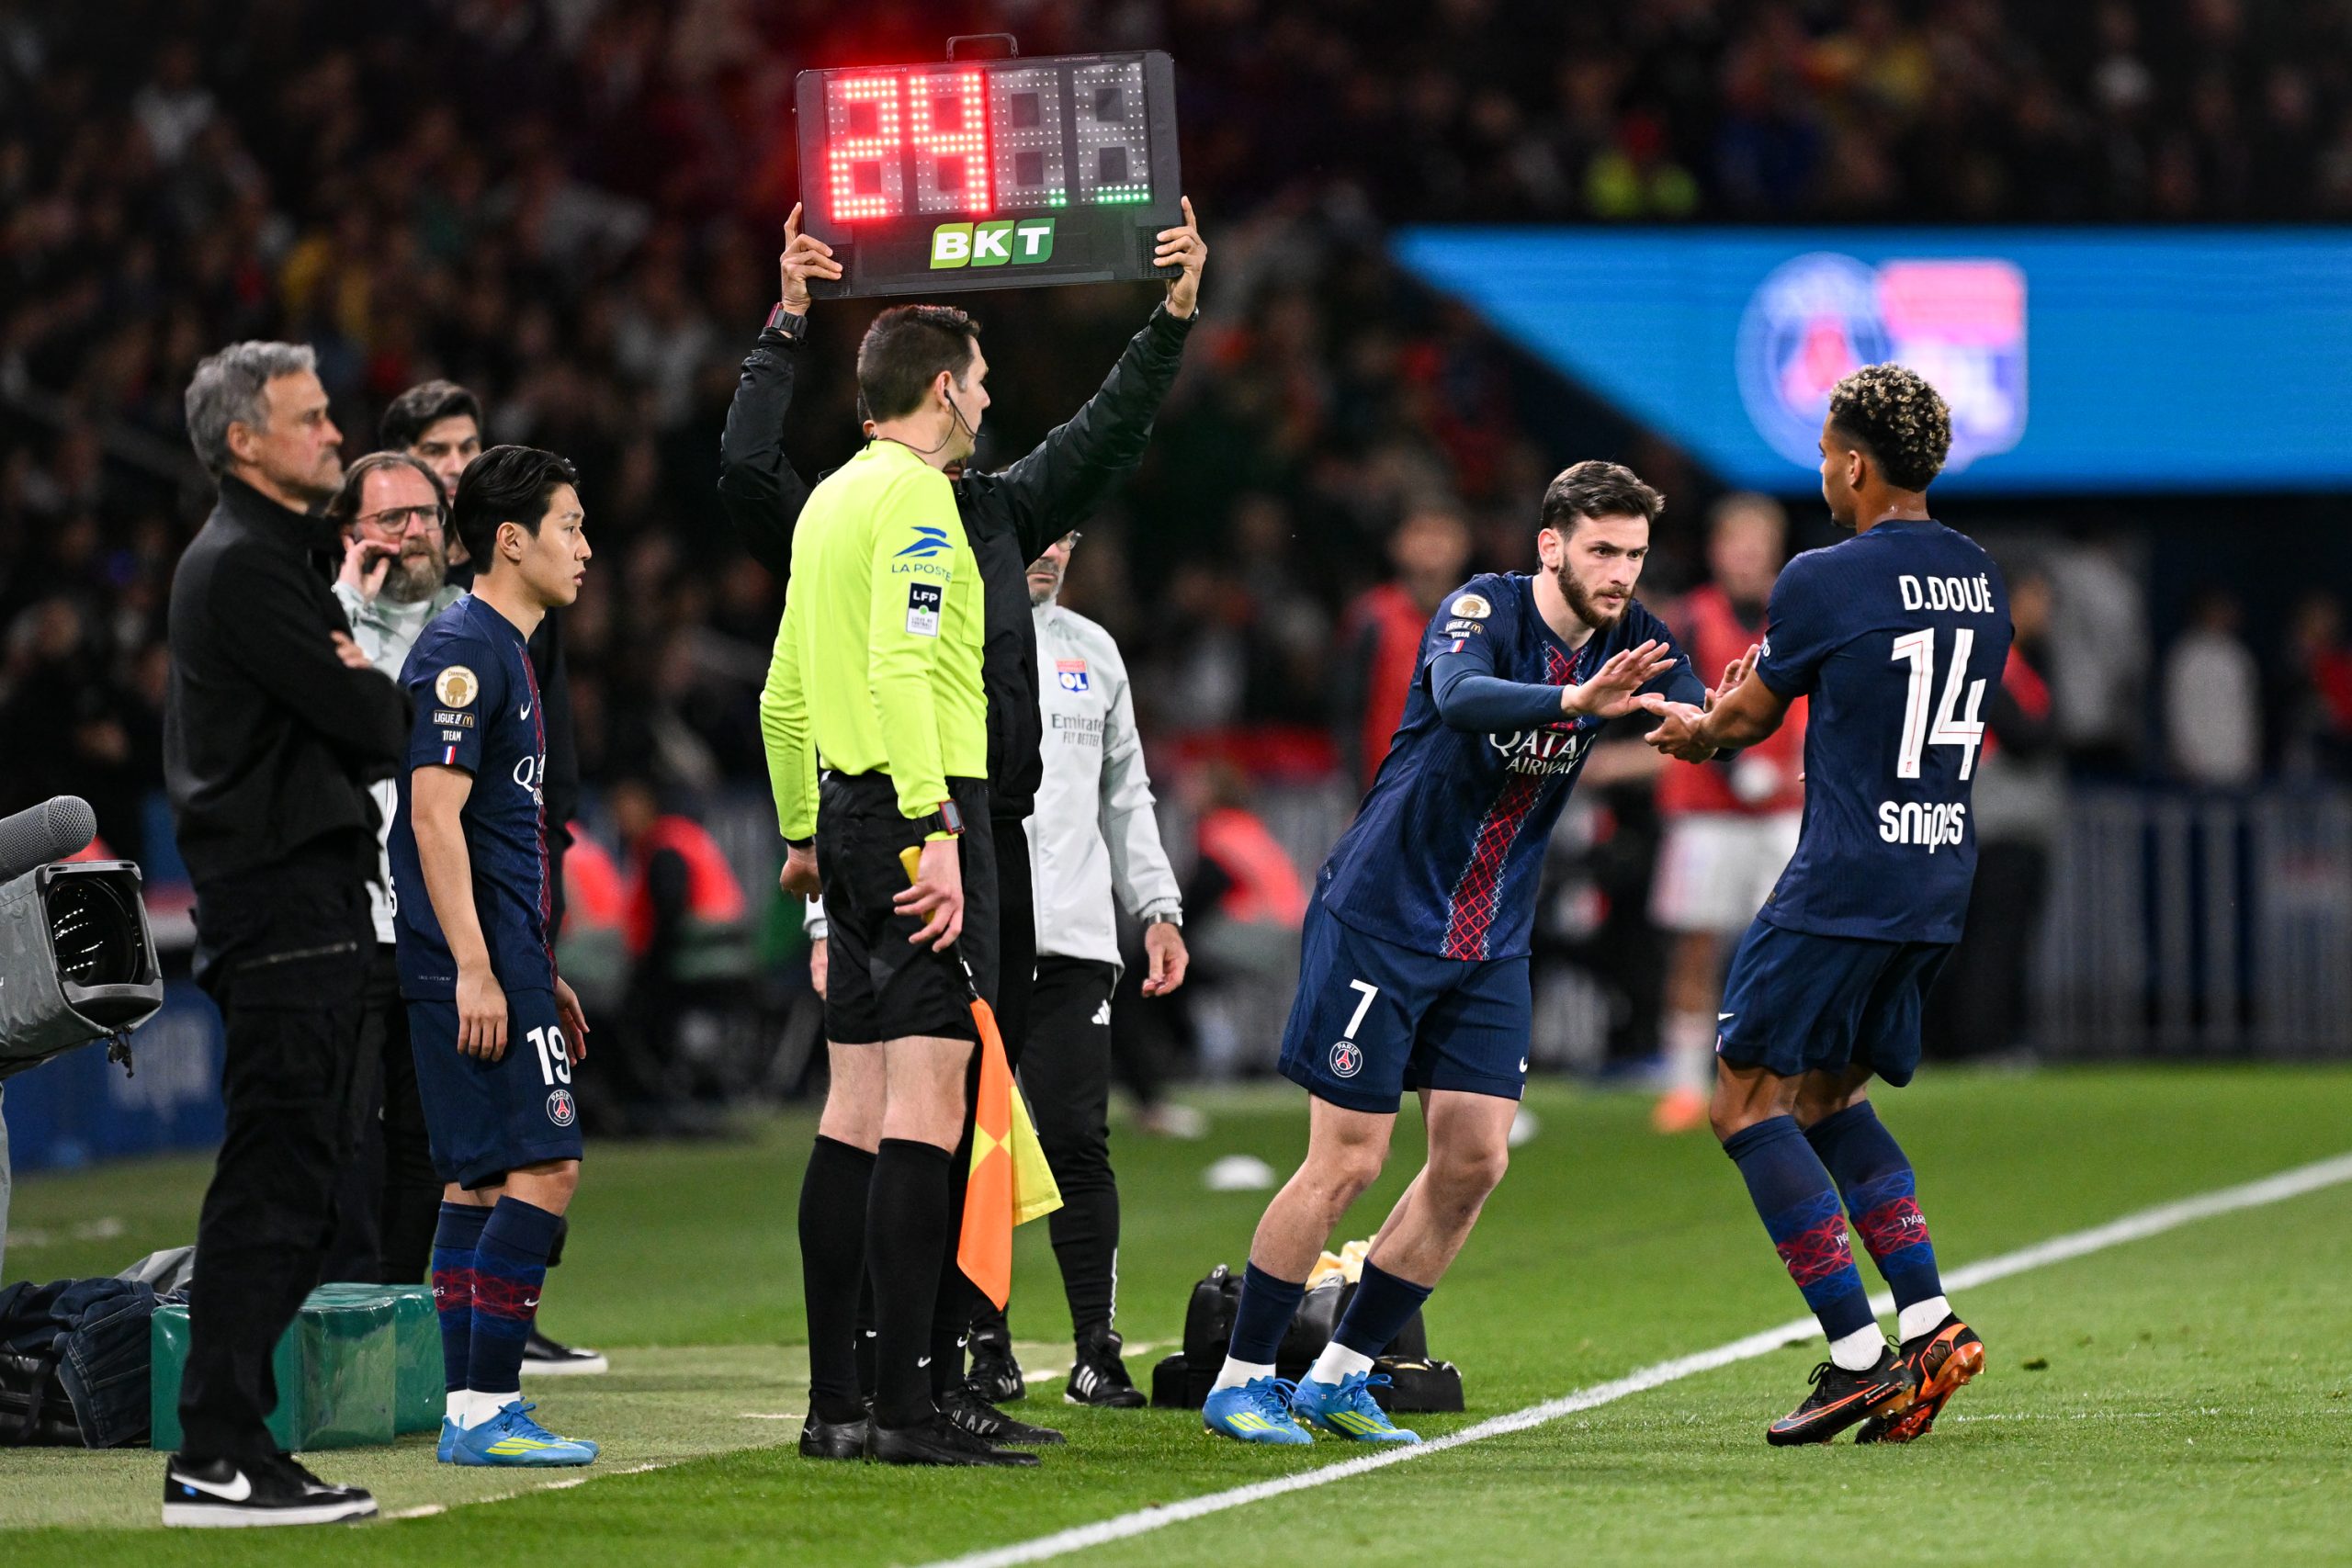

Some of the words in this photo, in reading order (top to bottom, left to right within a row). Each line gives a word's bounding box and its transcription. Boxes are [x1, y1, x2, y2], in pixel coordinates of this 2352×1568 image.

[828, 73, 989, 220] 24
[933, 226, 1051, 261] BKT
[891, 564, 910, 573] LA
[913, 563, 953, 582] POSTE
[912, 590, 939, 604] LFP
[1898, 571, 1995, 614] D.DOUÉ
[1060, 672, 1088, 690] OL
[1891, 626, 1986, 781] 14
[434, 712, 455, 724] LIGUE
[1051, 713, 1103, 733] Emirate
[1063, 731, 1075, 744] FLY
[1488, 729, 1597, 758] QATA
[1505, 757, 1580, 775] AIRWAY
[1343, 978, 1379, 1040] 7
[526, 1025, 571, 1086] 19
[1337, 1043, 1359, 1055] PARIS
[550, 1091, 570, 1101] PARIS
